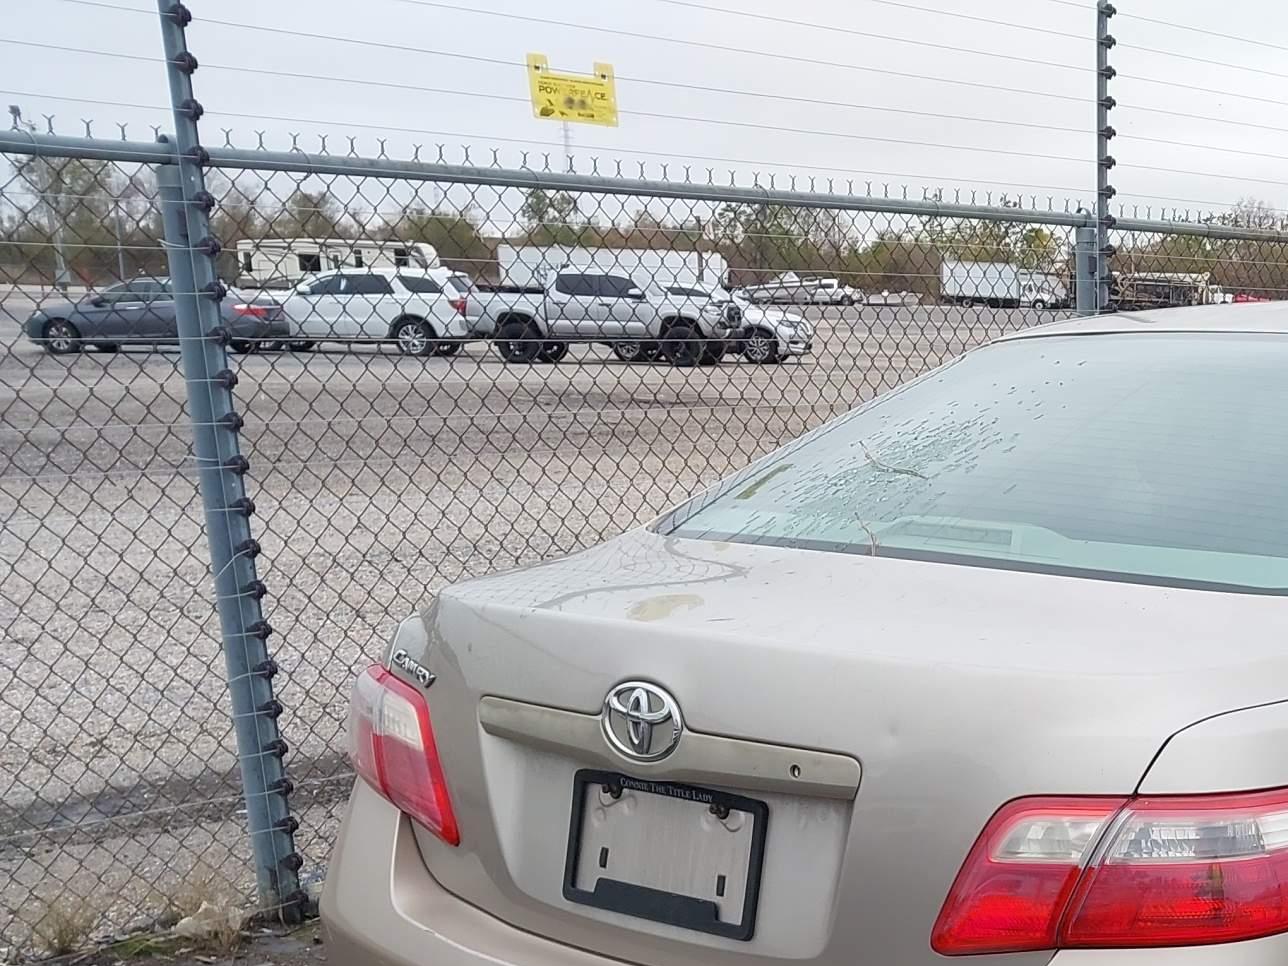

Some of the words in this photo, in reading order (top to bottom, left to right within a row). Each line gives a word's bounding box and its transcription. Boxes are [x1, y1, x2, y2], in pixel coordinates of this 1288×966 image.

[649, 783, 666, 794] THE
[666, 785, 691, 799] TITLE
[691, 790, 713, 803] LADY
